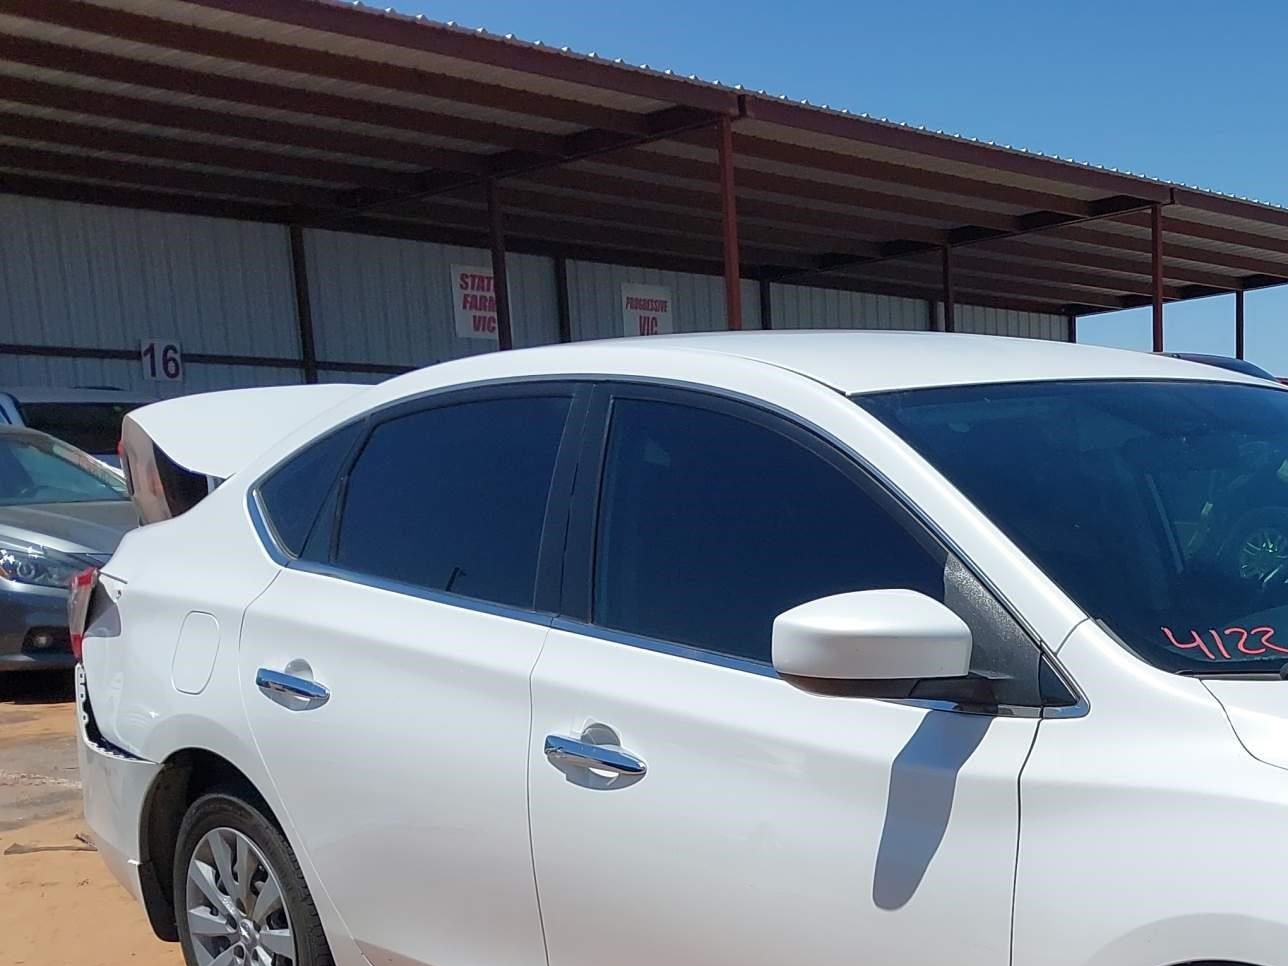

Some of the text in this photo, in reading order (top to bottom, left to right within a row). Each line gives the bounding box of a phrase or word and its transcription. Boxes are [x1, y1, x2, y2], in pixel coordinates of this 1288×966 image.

[460, 272, 496, 292] STAT
[472, 314, 497, 333] VIC
[639, 315, 658, 336] VIC
[143, 342, 180, 379] 16
